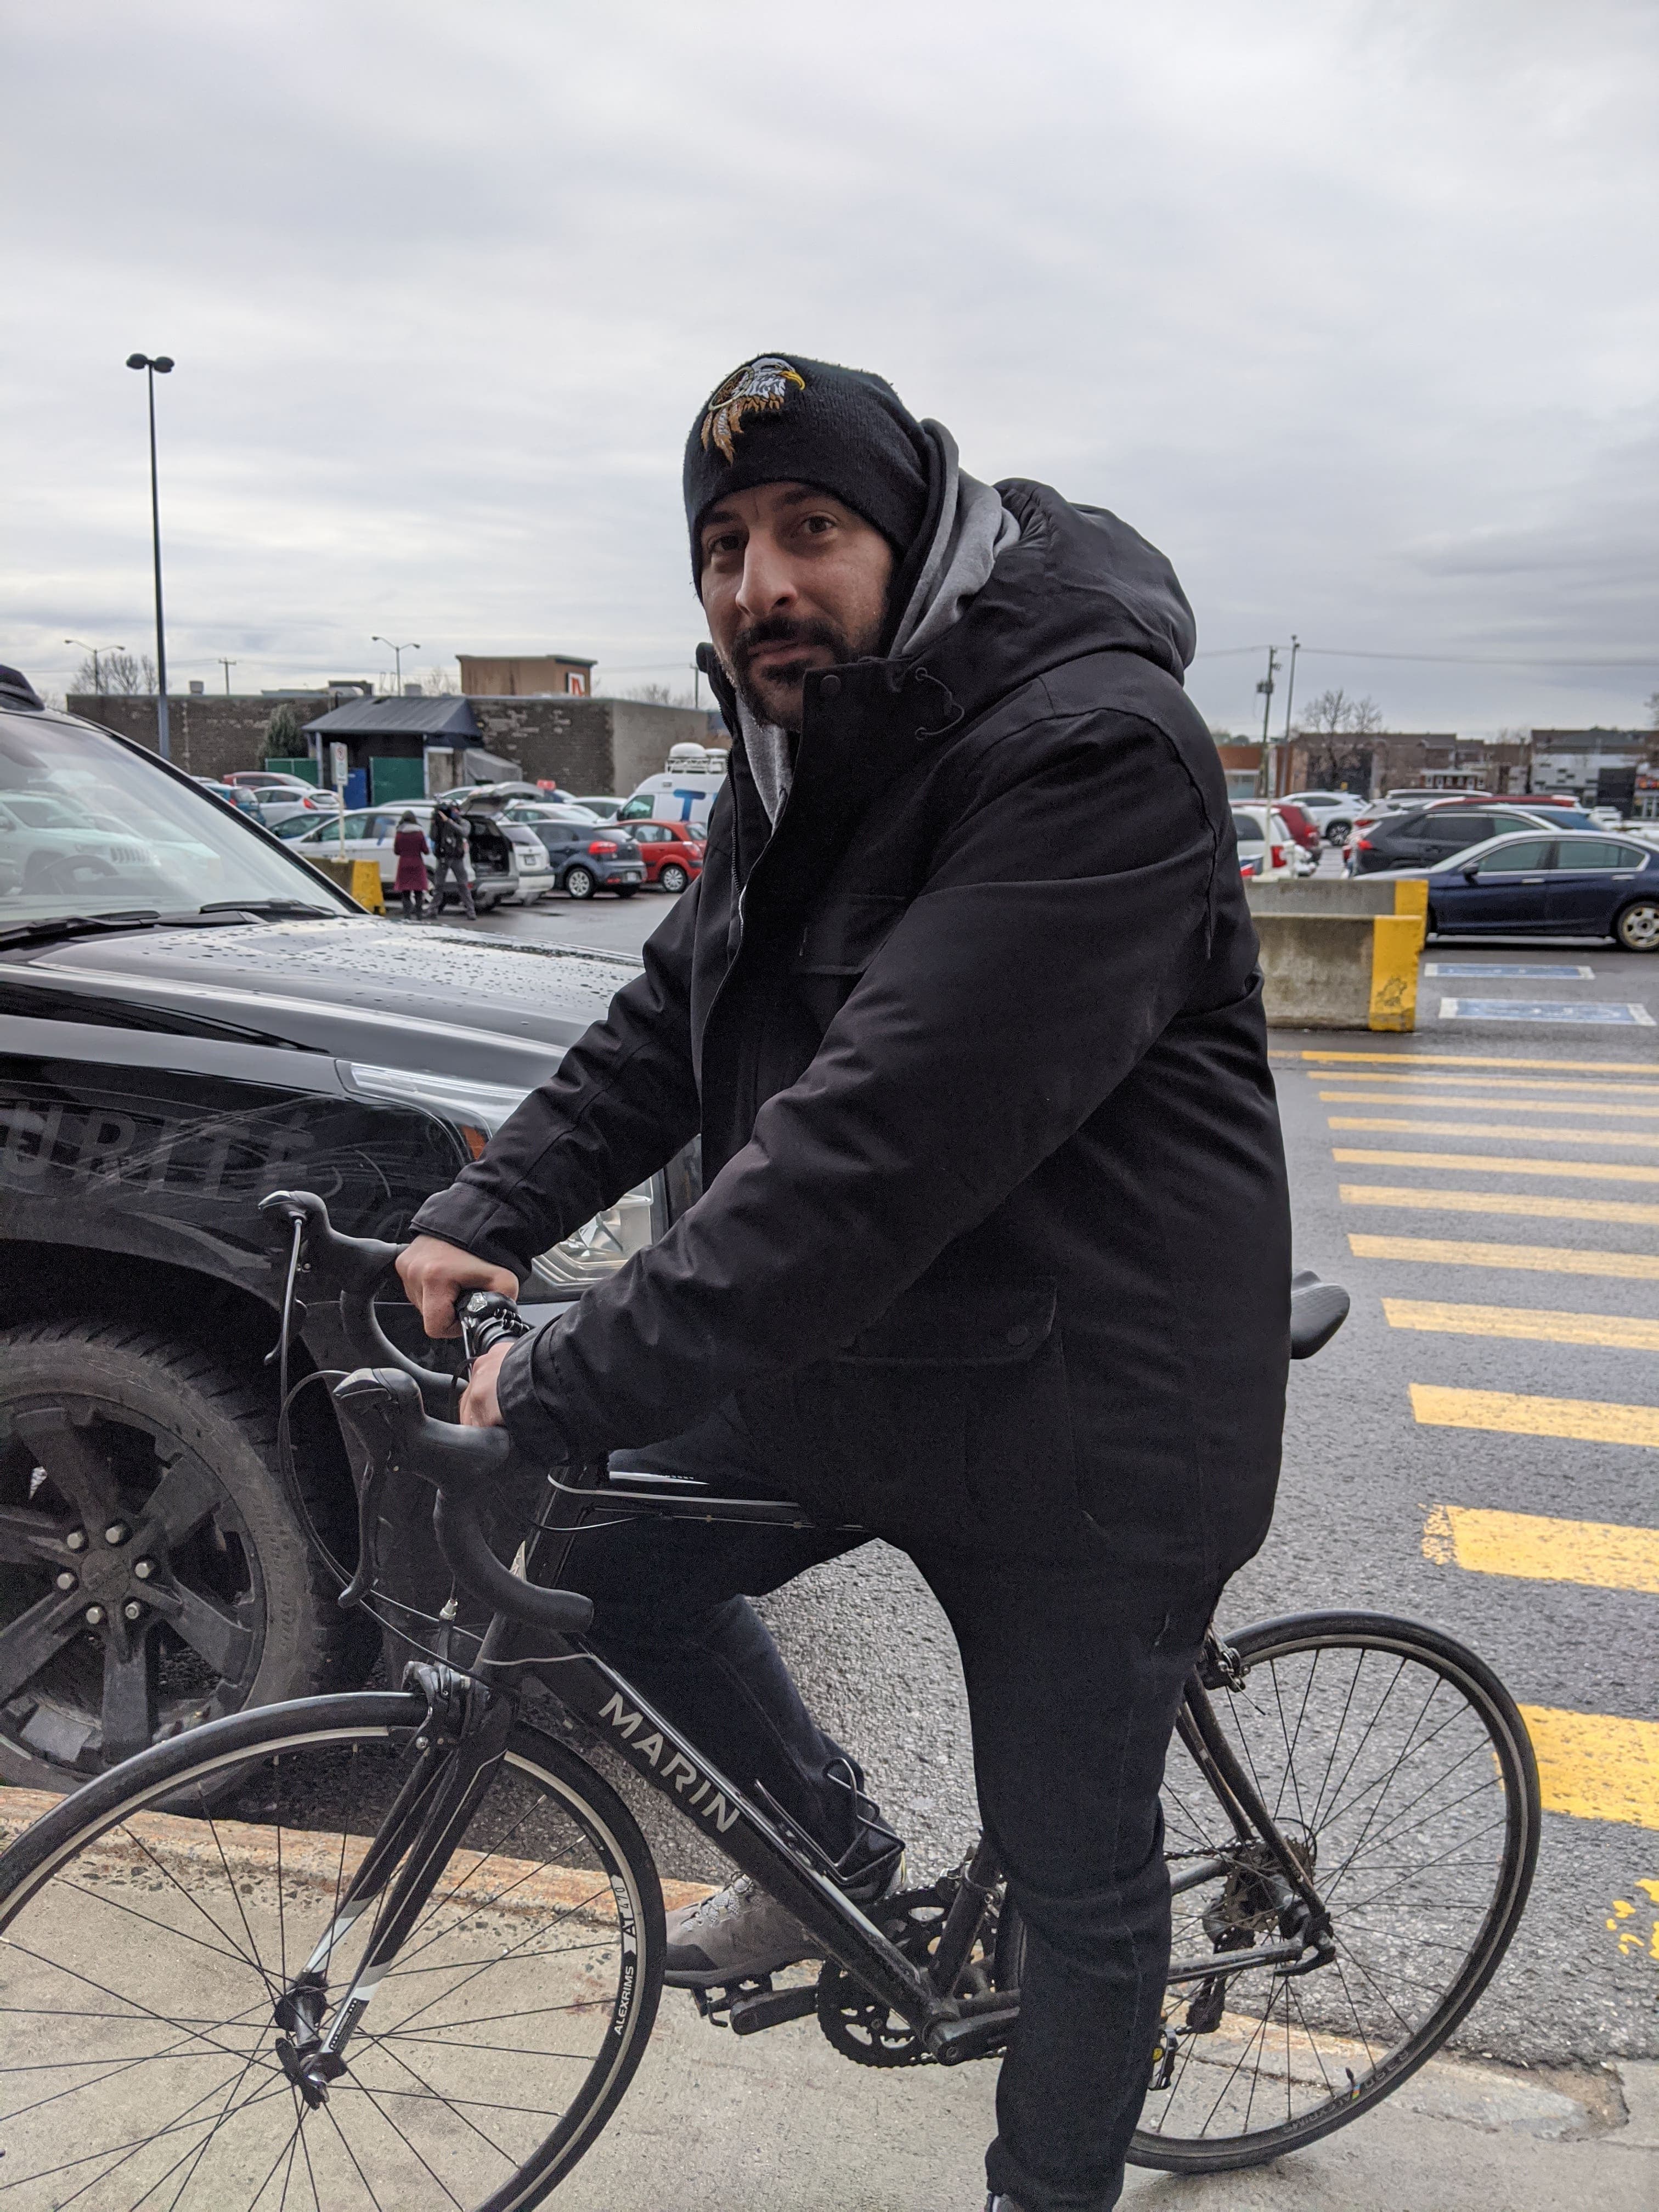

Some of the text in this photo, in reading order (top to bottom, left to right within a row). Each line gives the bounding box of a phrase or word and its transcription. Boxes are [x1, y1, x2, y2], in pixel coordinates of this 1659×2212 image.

[673, 788, 718, 822] T
[598, 1691, 740, 1833] MARIN
[614, 1887, 636, 2035] ALEXRIMS AT 470
